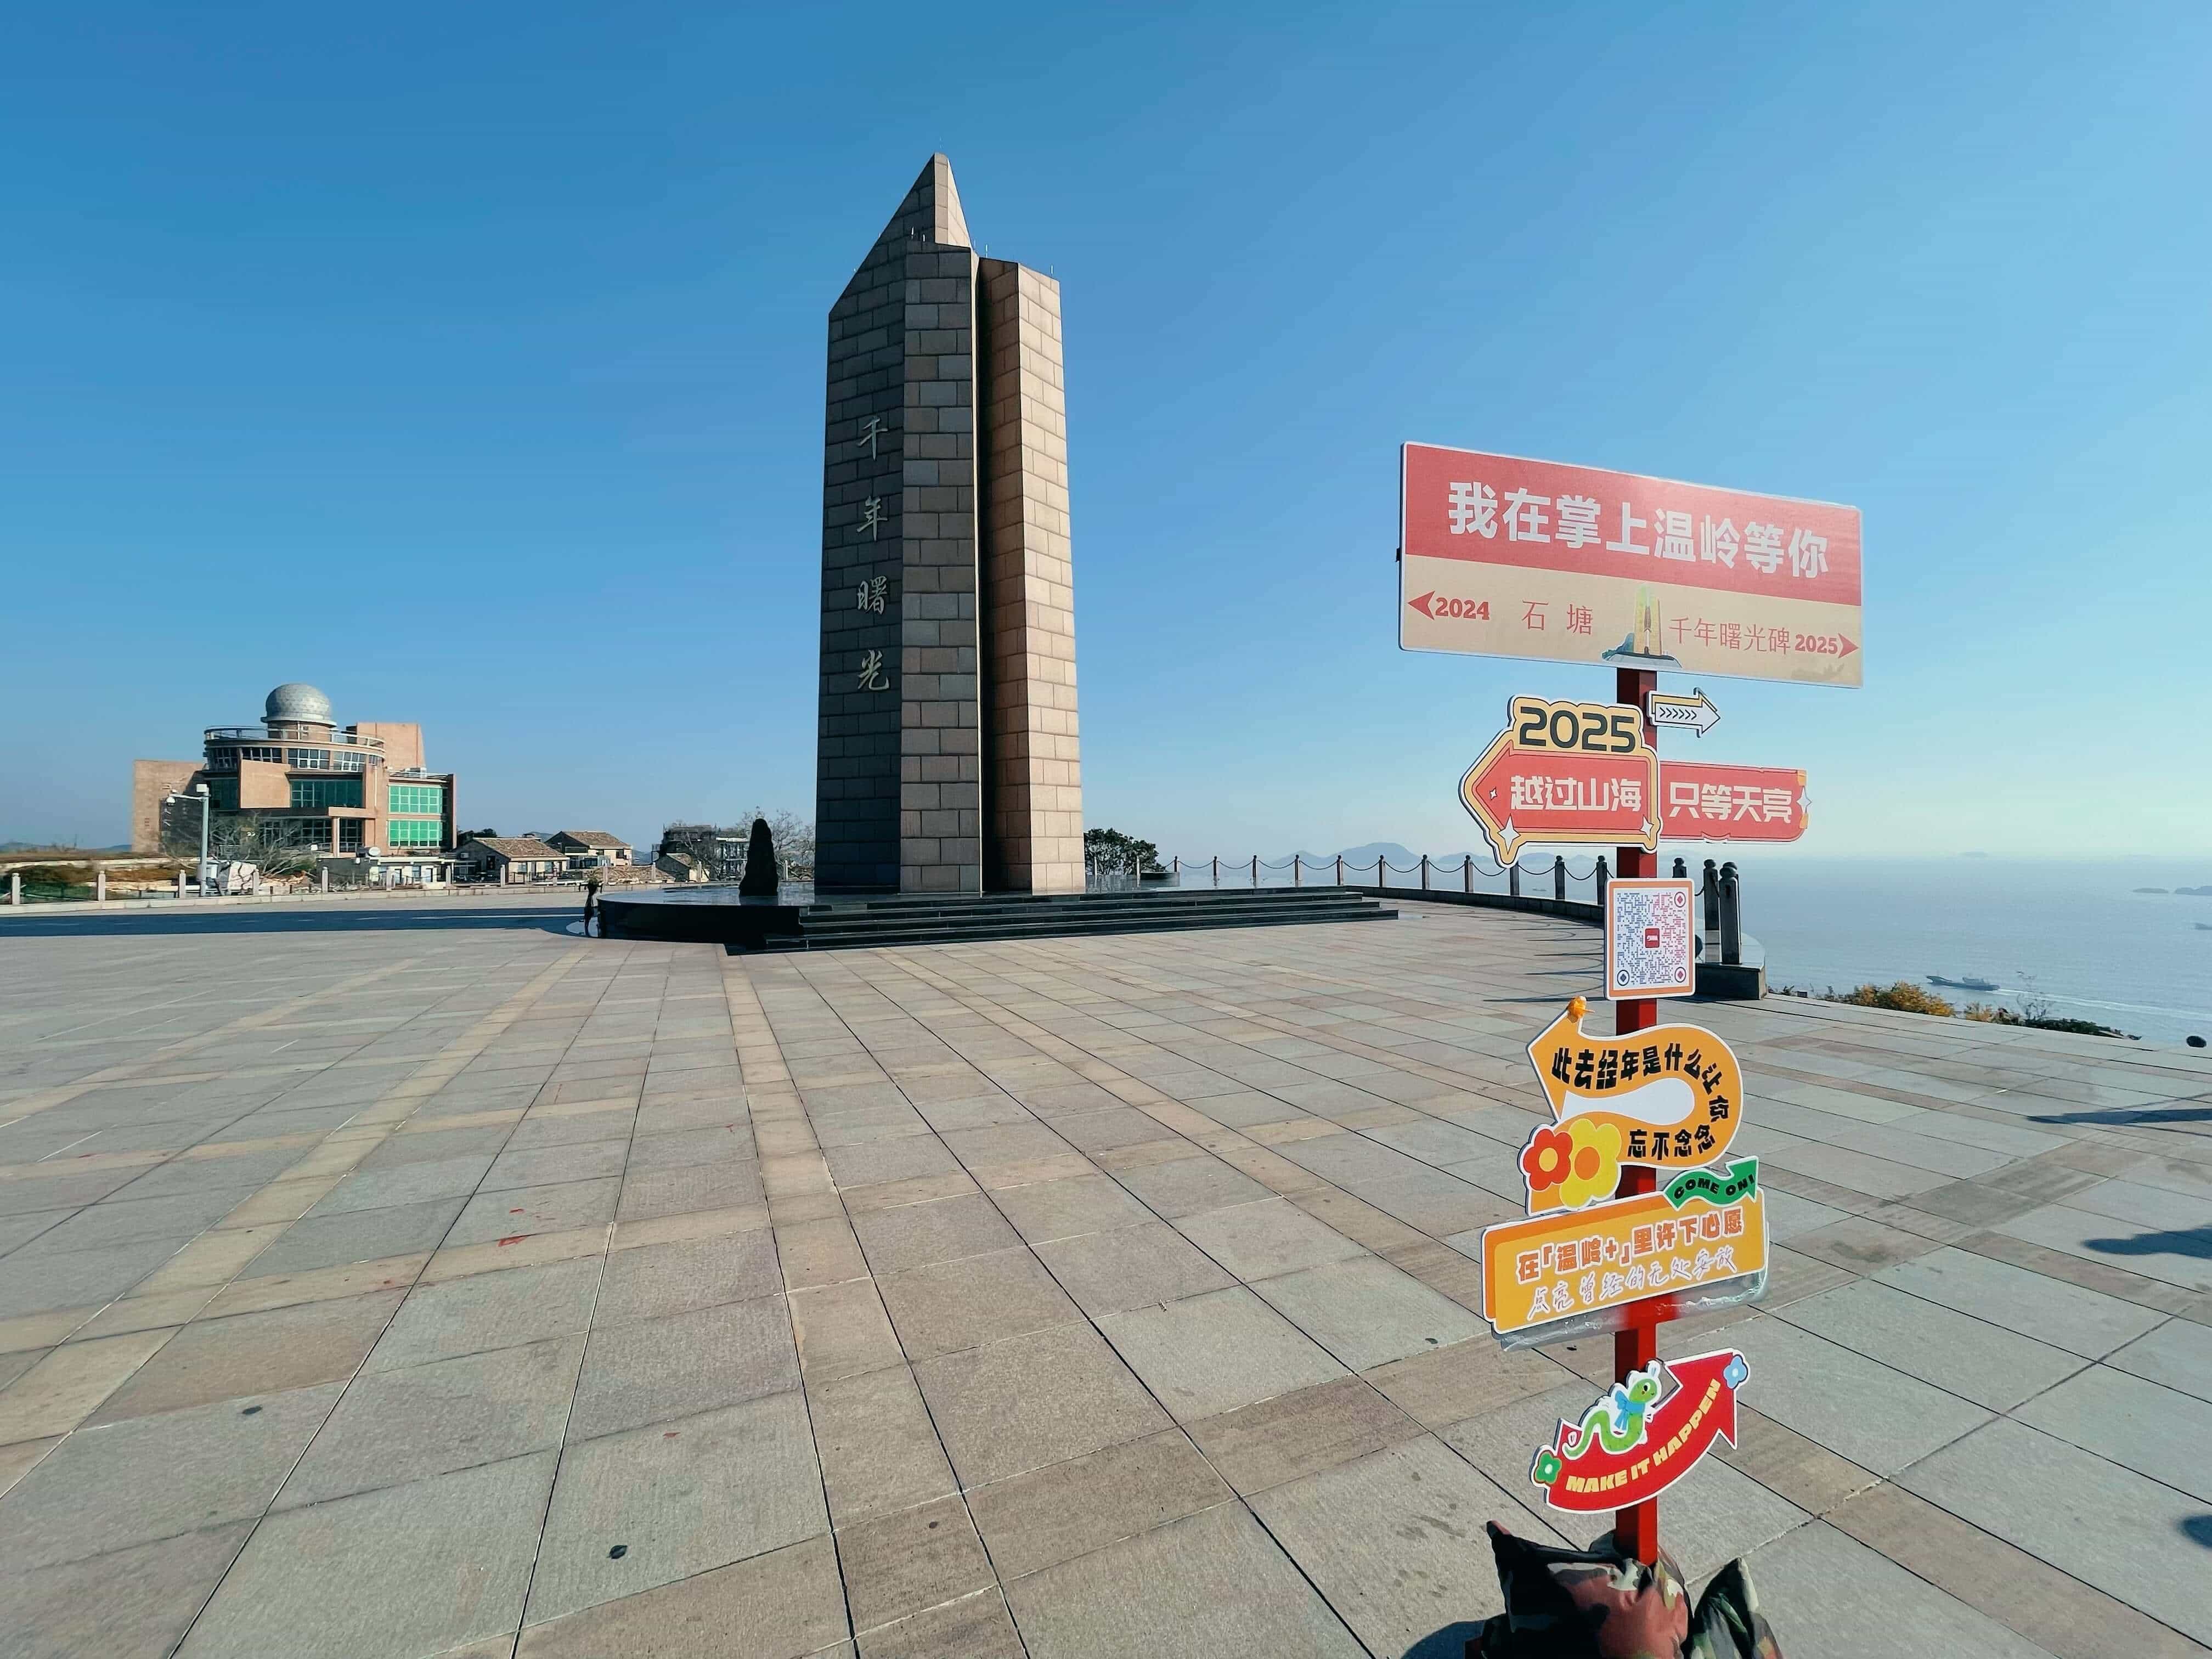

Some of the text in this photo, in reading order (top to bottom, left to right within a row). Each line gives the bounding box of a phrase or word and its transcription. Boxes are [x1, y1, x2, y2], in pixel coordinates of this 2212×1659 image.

[857, 416, 889, 691] 千年曙光
[1448, 481, 1829, 579] 我在掌上温岭等你
[1435, 597, 1490, 620] 2024
[1668, 617, 1791, 655] 千年曙光碑
[1795, 634, 1838, 654] 2025
[1519, 707, 1635, 753] 2025
[1510, 775, 1641, 811] 越过山海
[1669, 782, 1792, 823] 只等天亮
[1674, 1174, 1755, 1199] COME ON!
[1565, 1379, 1721, 1493] MAKE IT HAPPEN
